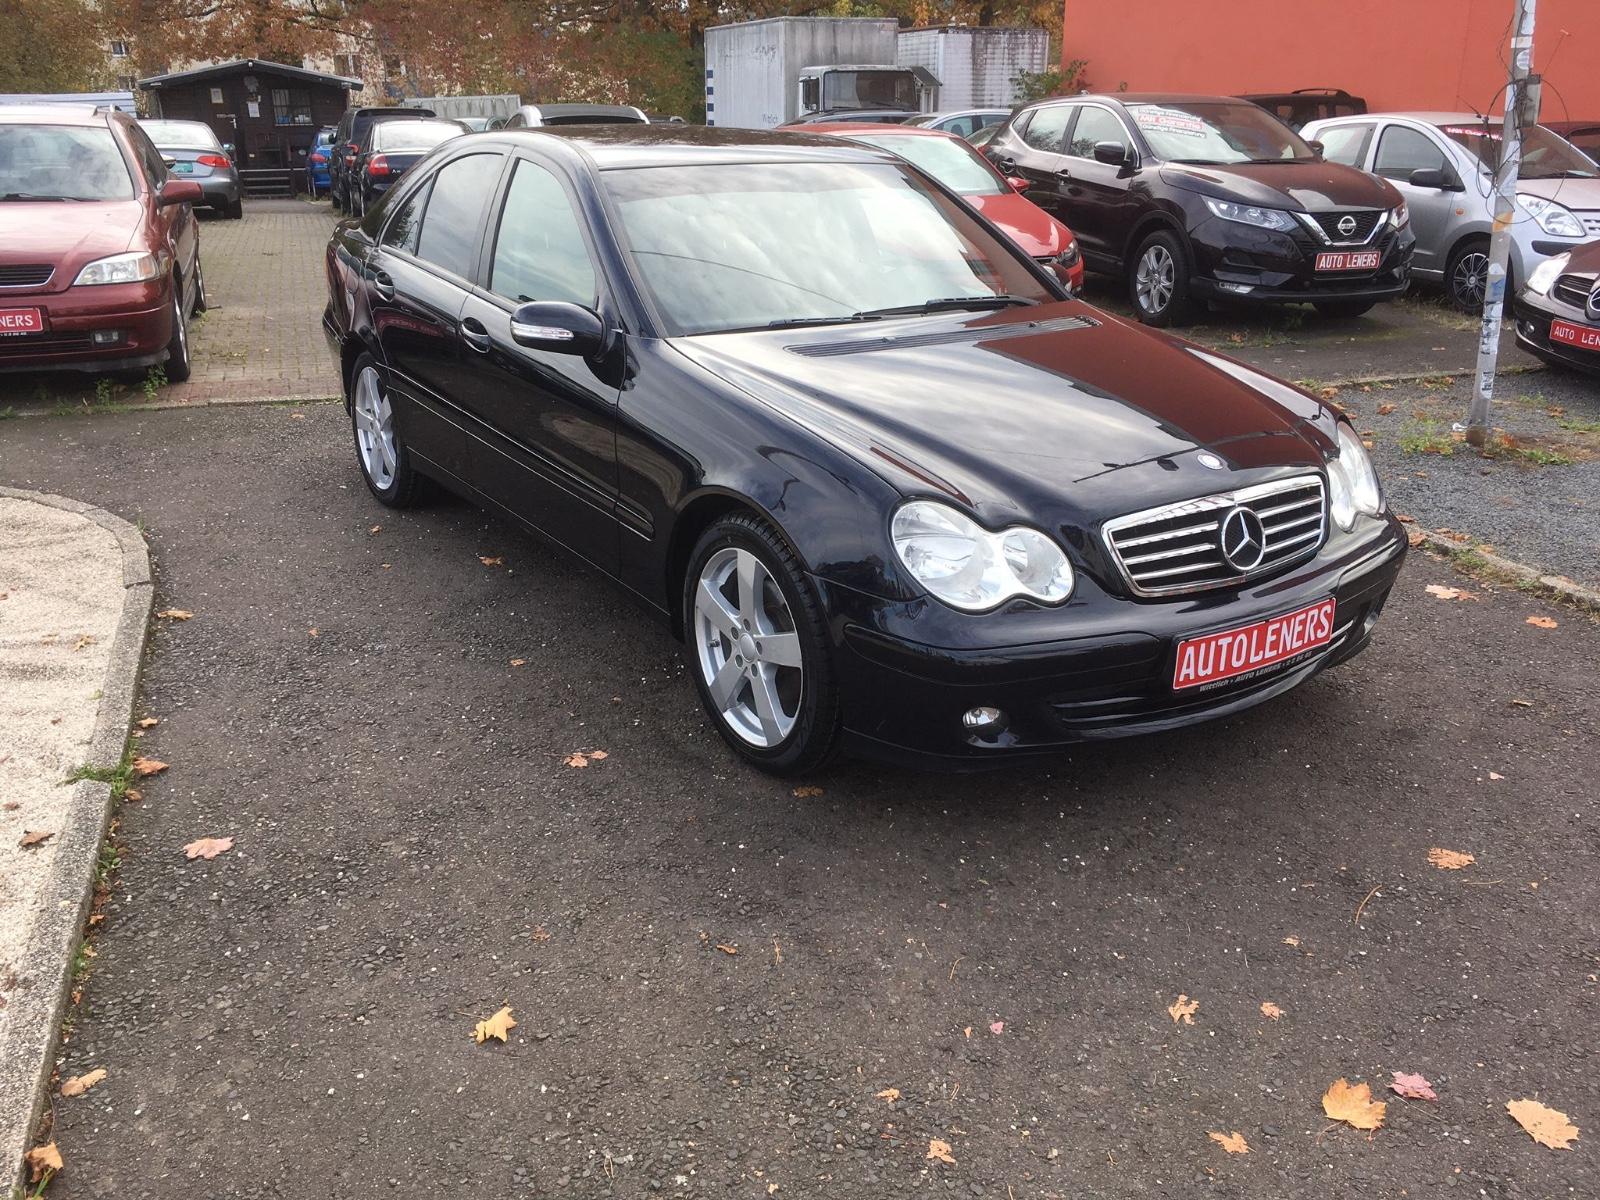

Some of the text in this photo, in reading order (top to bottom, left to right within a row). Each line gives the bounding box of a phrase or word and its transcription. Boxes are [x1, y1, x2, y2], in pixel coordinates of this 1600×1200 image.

[1319, 253, 1377, 269] AUTO LENERS
[1554, 326, 1575, 340] AUTO
[1234, 671, 1255, 683] AUTO
